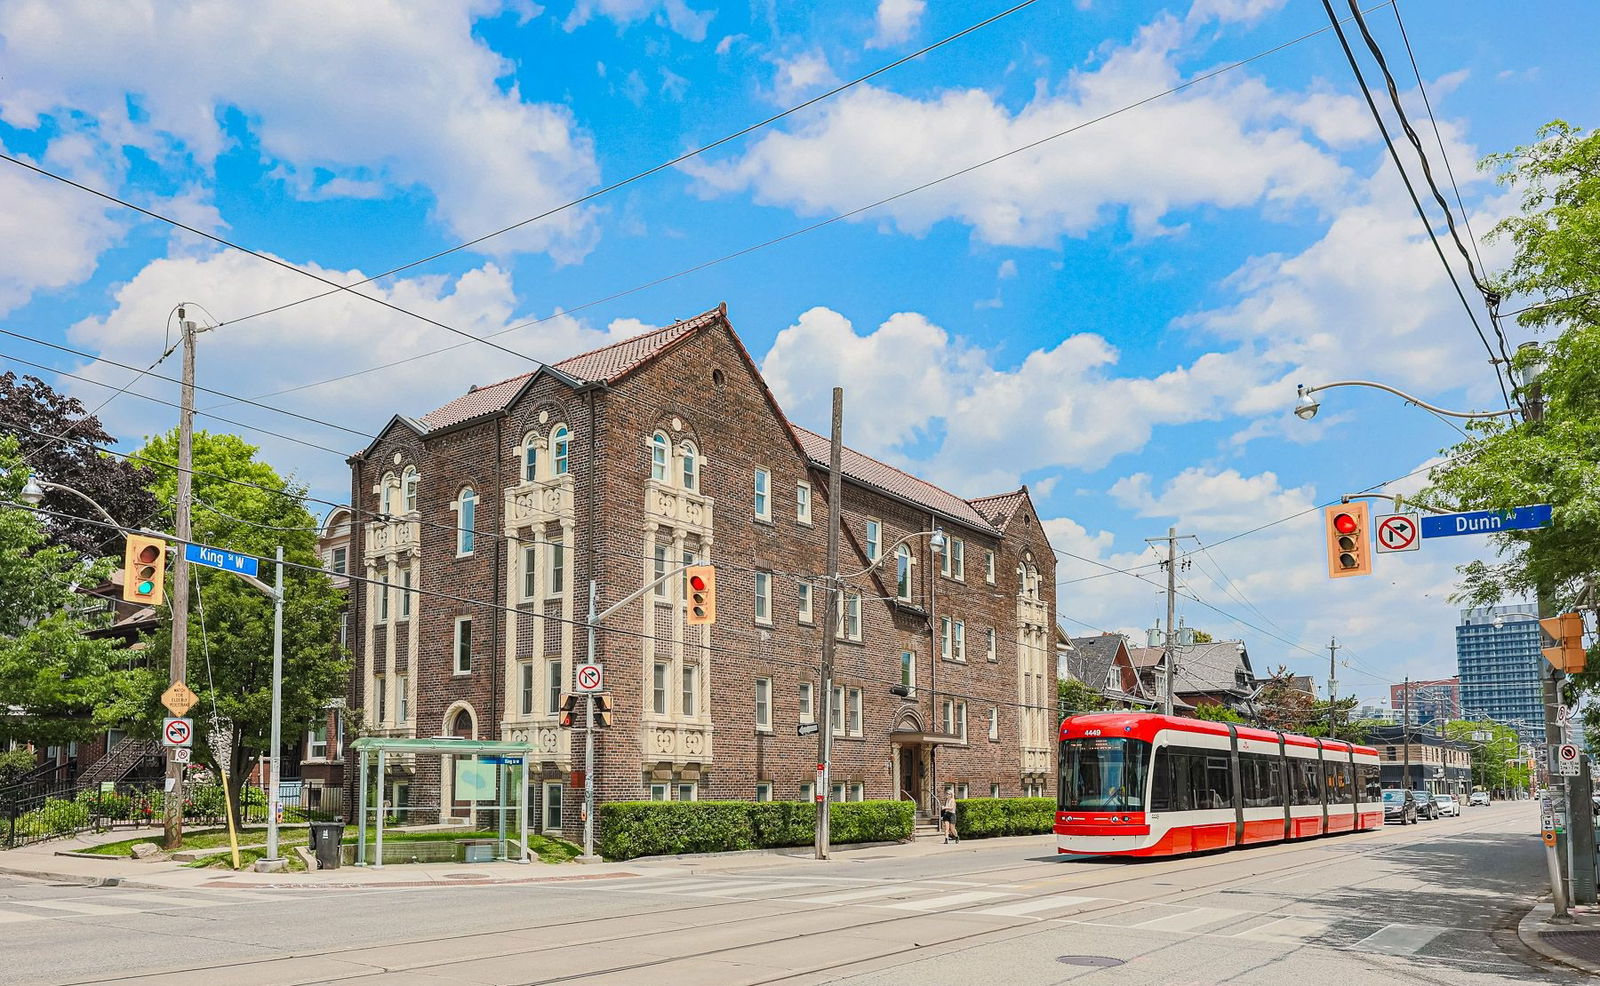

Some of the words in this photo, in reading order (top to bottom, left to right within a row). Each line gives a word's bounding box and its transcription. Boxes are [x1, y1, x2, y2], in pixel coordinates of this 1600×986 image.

[1456, 516, 1501, 532] Dunn
[1505, 512, 1517, 521] Av
[200, 547, 223, 567] King
[235, 556, 244, 569] W
